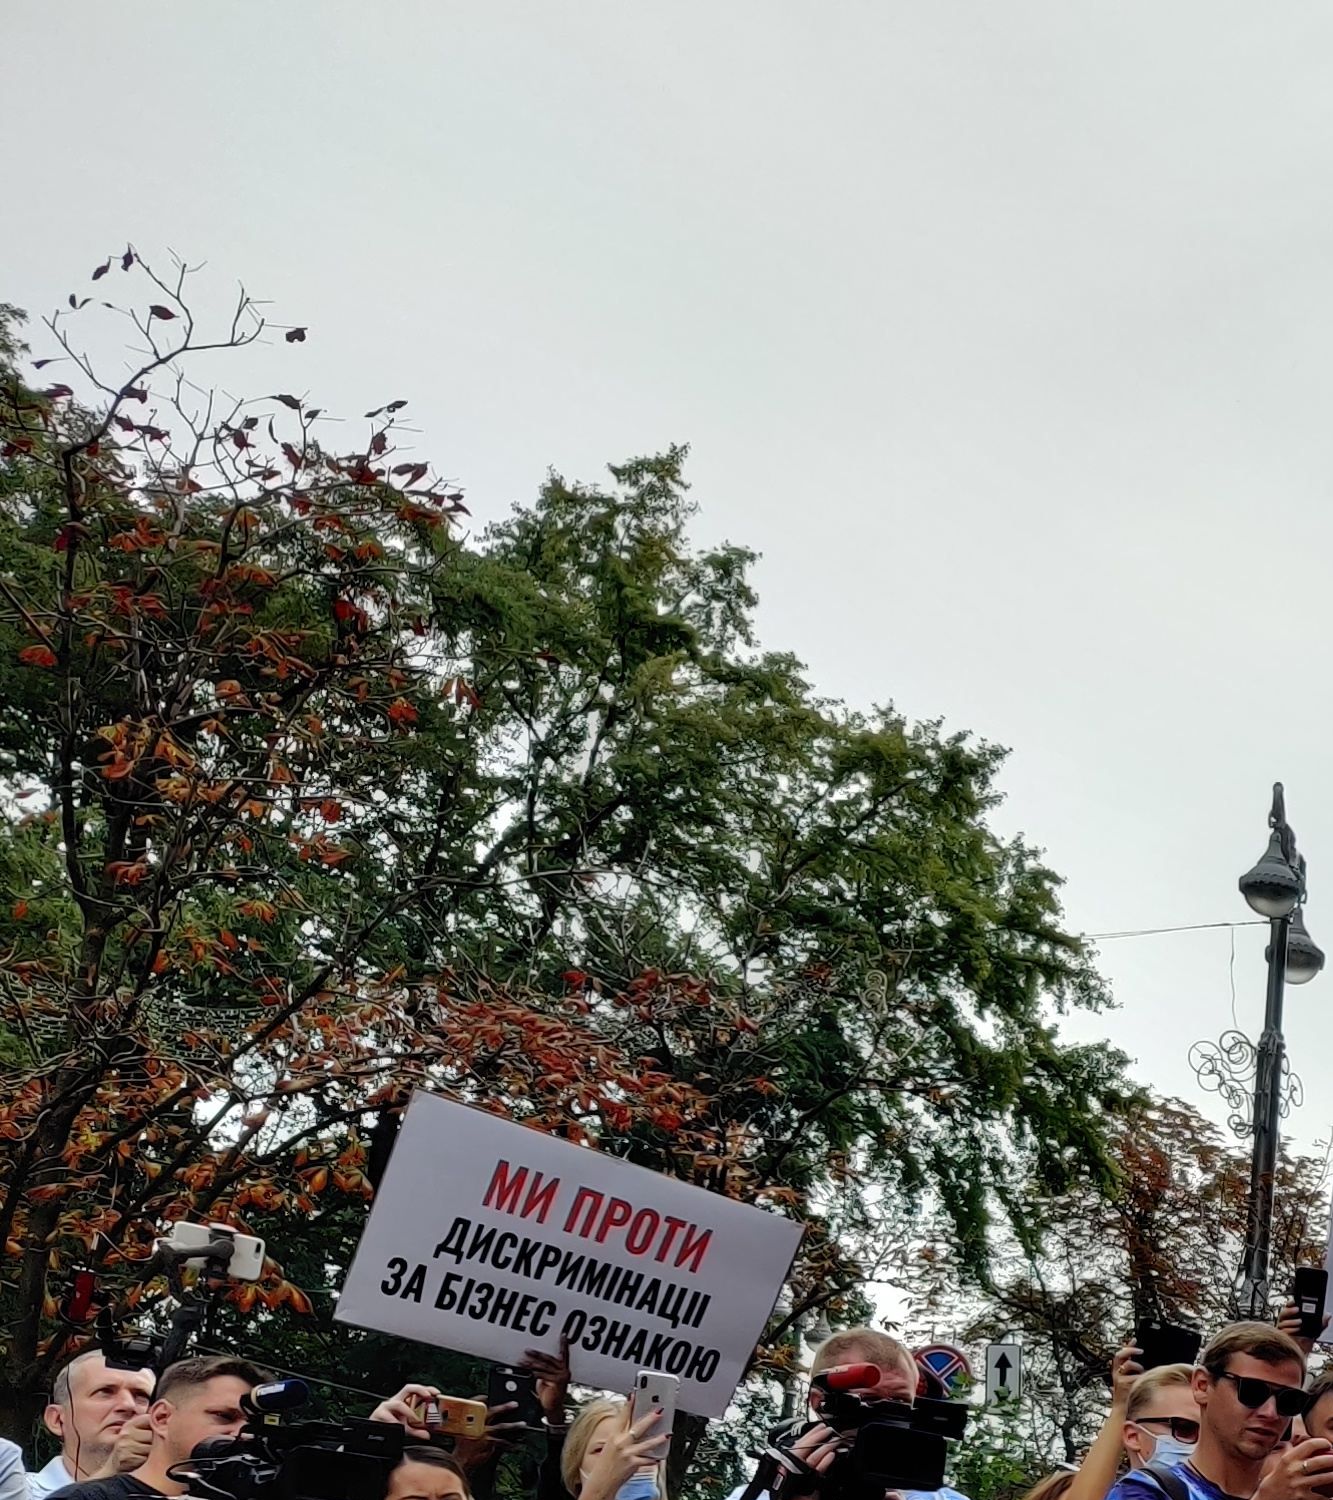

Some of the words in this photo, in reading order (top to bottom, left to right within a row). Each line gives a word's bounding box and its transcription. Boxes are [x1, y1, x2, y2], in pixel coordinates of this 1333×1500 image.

[482, 1159, 560, 1224] МИ
[563, 1186, 714, 1274] ПРОТИ
[380, 1257, 428, 1304] ЗА
[434, 1272, 557, 1338] БІЗНЕС
[561, 1310, 721, 1384] ОЗНАКОЮ
